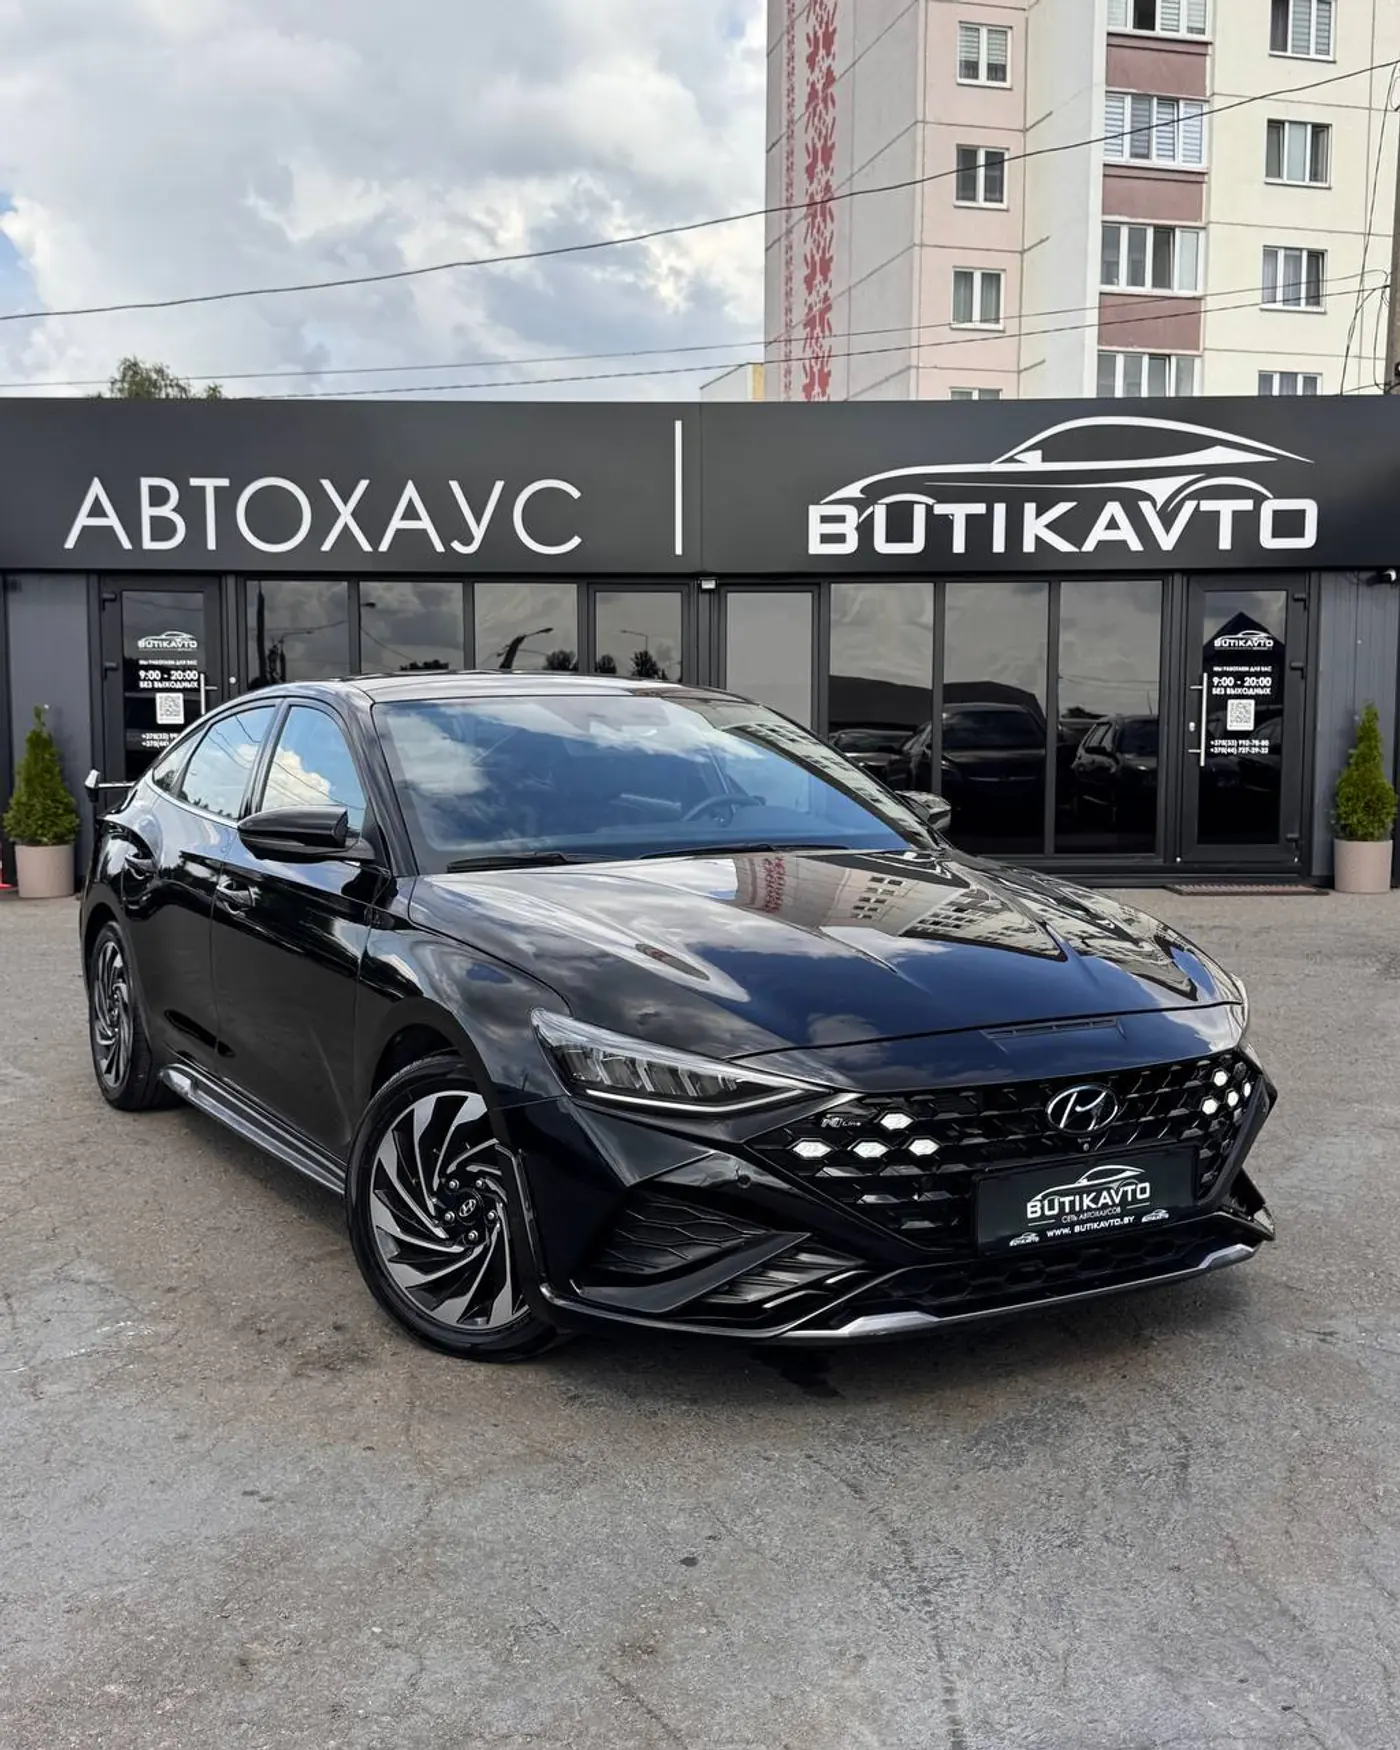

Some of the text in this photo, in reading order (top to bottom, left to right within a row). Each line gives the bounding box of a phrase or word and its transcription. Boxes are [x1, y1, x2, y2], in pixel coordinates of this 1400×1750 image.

[64, 476, 583, 555] АВТОХАУС
[808, 497, 1318, 555] BUTIKAVTO
[1214, 638, 1274, 647] BUTIKAVTO
[139, 669, 162, 680] 9:00
[170, 669, 199, 681] 20:00
[1212, 676, 1235, 687] 9:00
[1243, 676, 1272, 687] 20:00
[153, 681, 199, 689] ВЫХОДНЫХ
[1212, 687, 1271, 695] БЕЗ ВЫХОДНЫХ
[1027, 1182, 1150, 1219] BUTIKAVTO
[1078, 1206, 1122, 1221] АВТОХАУСОВ
[1074, 1215, 1136, 1234] BUTIKAVTO.BY
